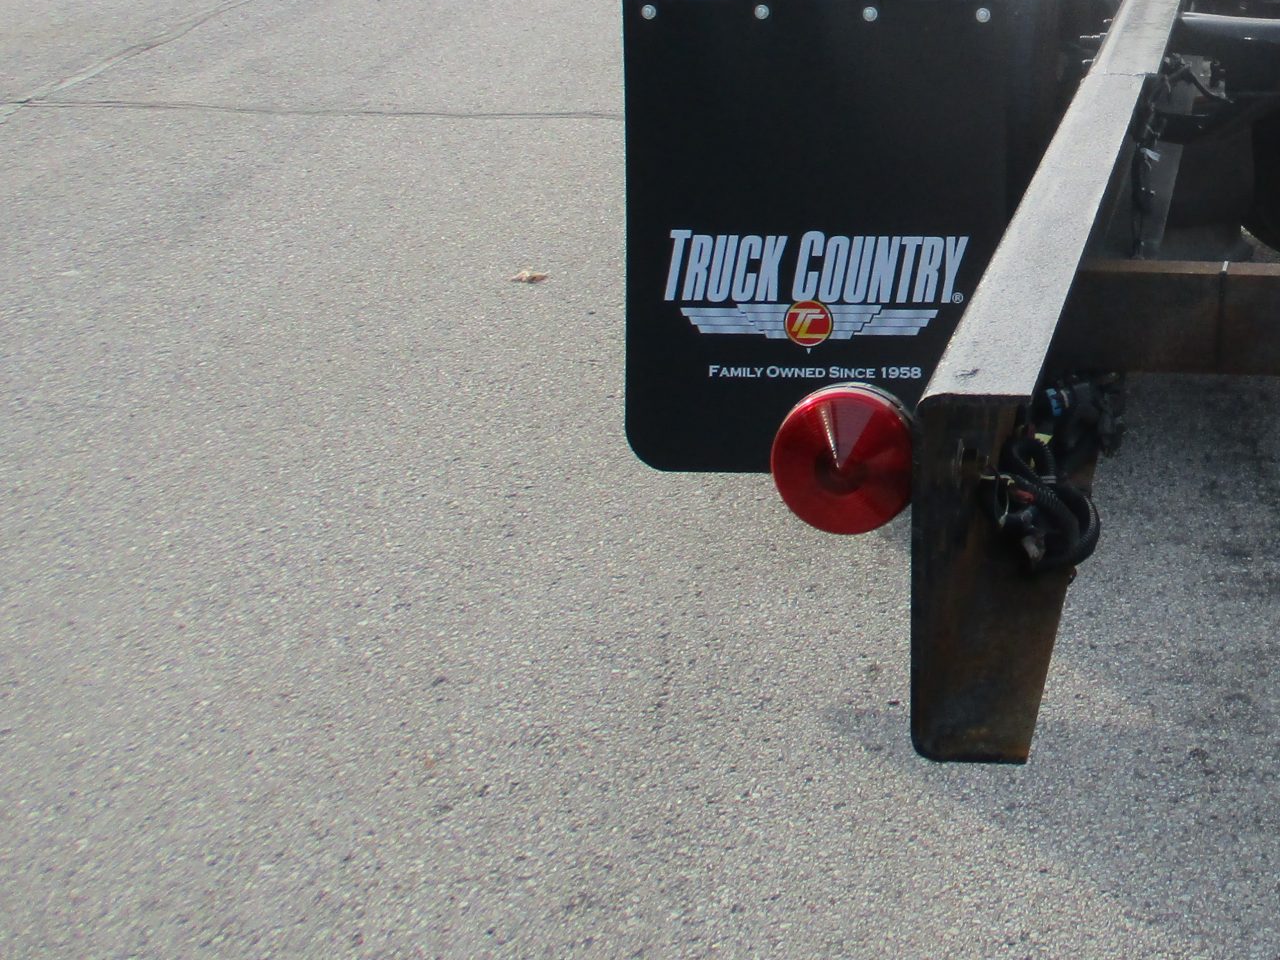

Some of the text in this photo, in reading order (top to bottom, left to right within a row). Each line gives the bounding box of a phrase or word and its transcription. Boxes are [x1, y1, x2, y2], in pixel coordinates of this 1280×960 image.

[664, 229, 969, 304] TRUCK COUNTRY
[708, 365, 922, 380] FAMILY OWNED SINCE 1958
